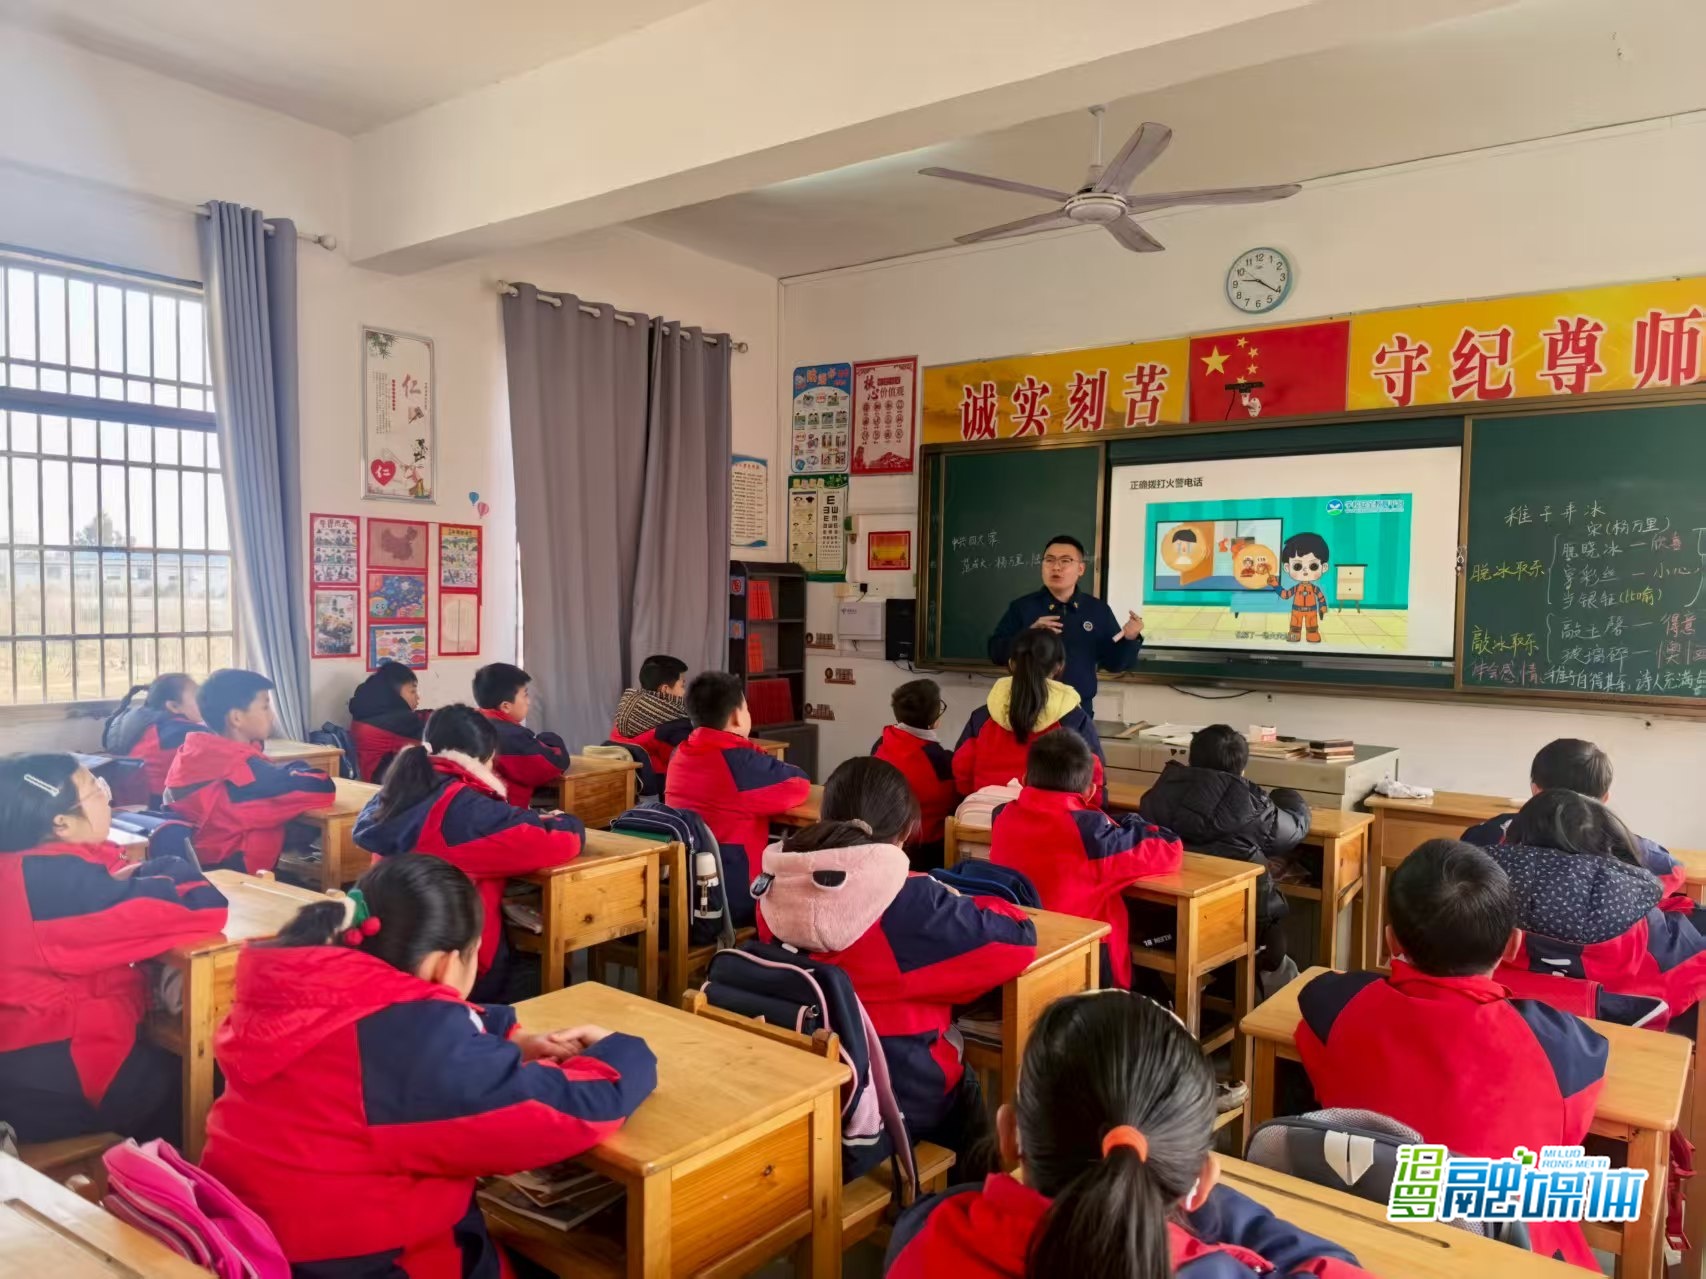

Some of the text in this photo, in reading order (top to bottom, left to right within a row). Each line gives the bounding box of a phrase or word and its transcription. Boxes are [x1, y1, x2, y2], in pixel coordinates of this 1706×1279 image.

[1255, 253, 1264, 262] 12
[1246, 258, 1252, 266] 11
[1276, 262, 1283, 270] 2
[1236, 267, 1245, 277] 10
[1280, 273, 1286, 281] 3
[1232, 280, 1239, 288] 9
[1236, 292, 1242, 300] 8
[1266, 295, 1273, 303] 5
[1245, 298, 1250, 306] 7
[1255, 300, 1261, 308] 6
[1372, 307, 1704, 407] 守纪尊师
[402, 373, 422, 398] 仁
[961, 364, 1169, 440] 诚实刻苦
[375, 465, 391, 479] 仁
[1129, 477, 1204, 490] 正确拨打火警电话
